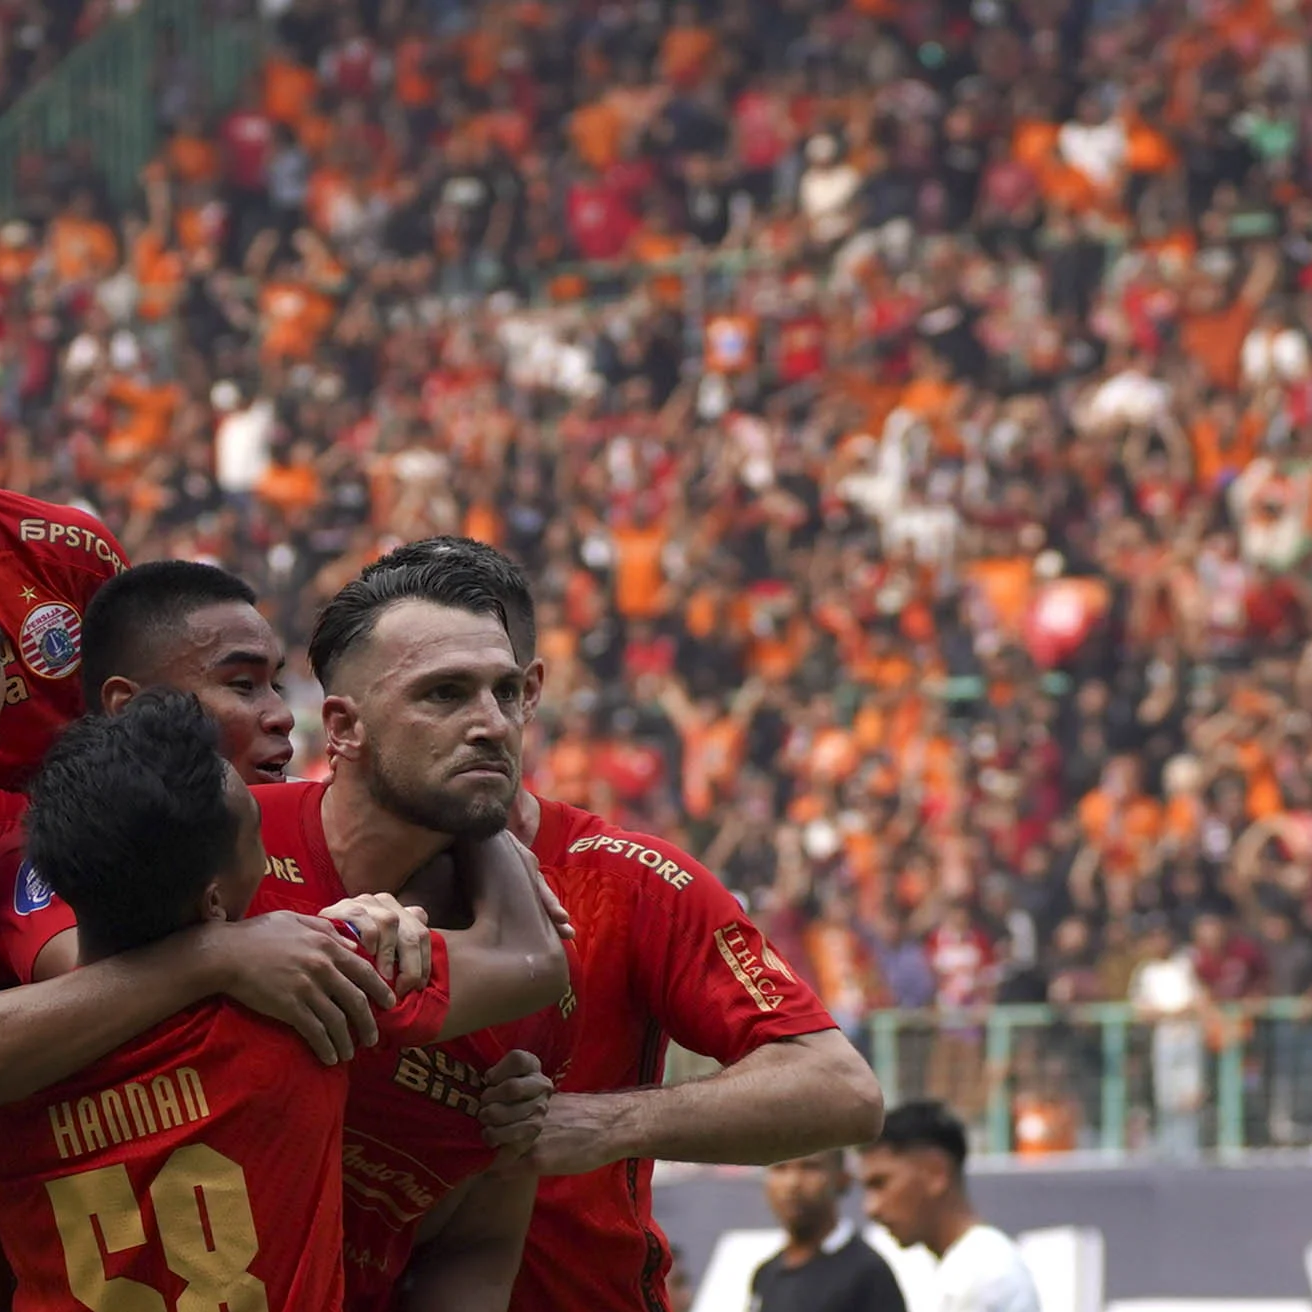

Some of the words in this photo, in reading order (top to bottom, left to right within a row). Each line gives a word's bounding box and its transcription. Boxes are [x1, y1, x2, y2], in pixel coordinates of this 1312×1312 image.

[25, 607, 62, 632] PERSIJA
[722, 921, 784, 1010] ITHACA
[48, 1066, 211, 1159] HANNAN
